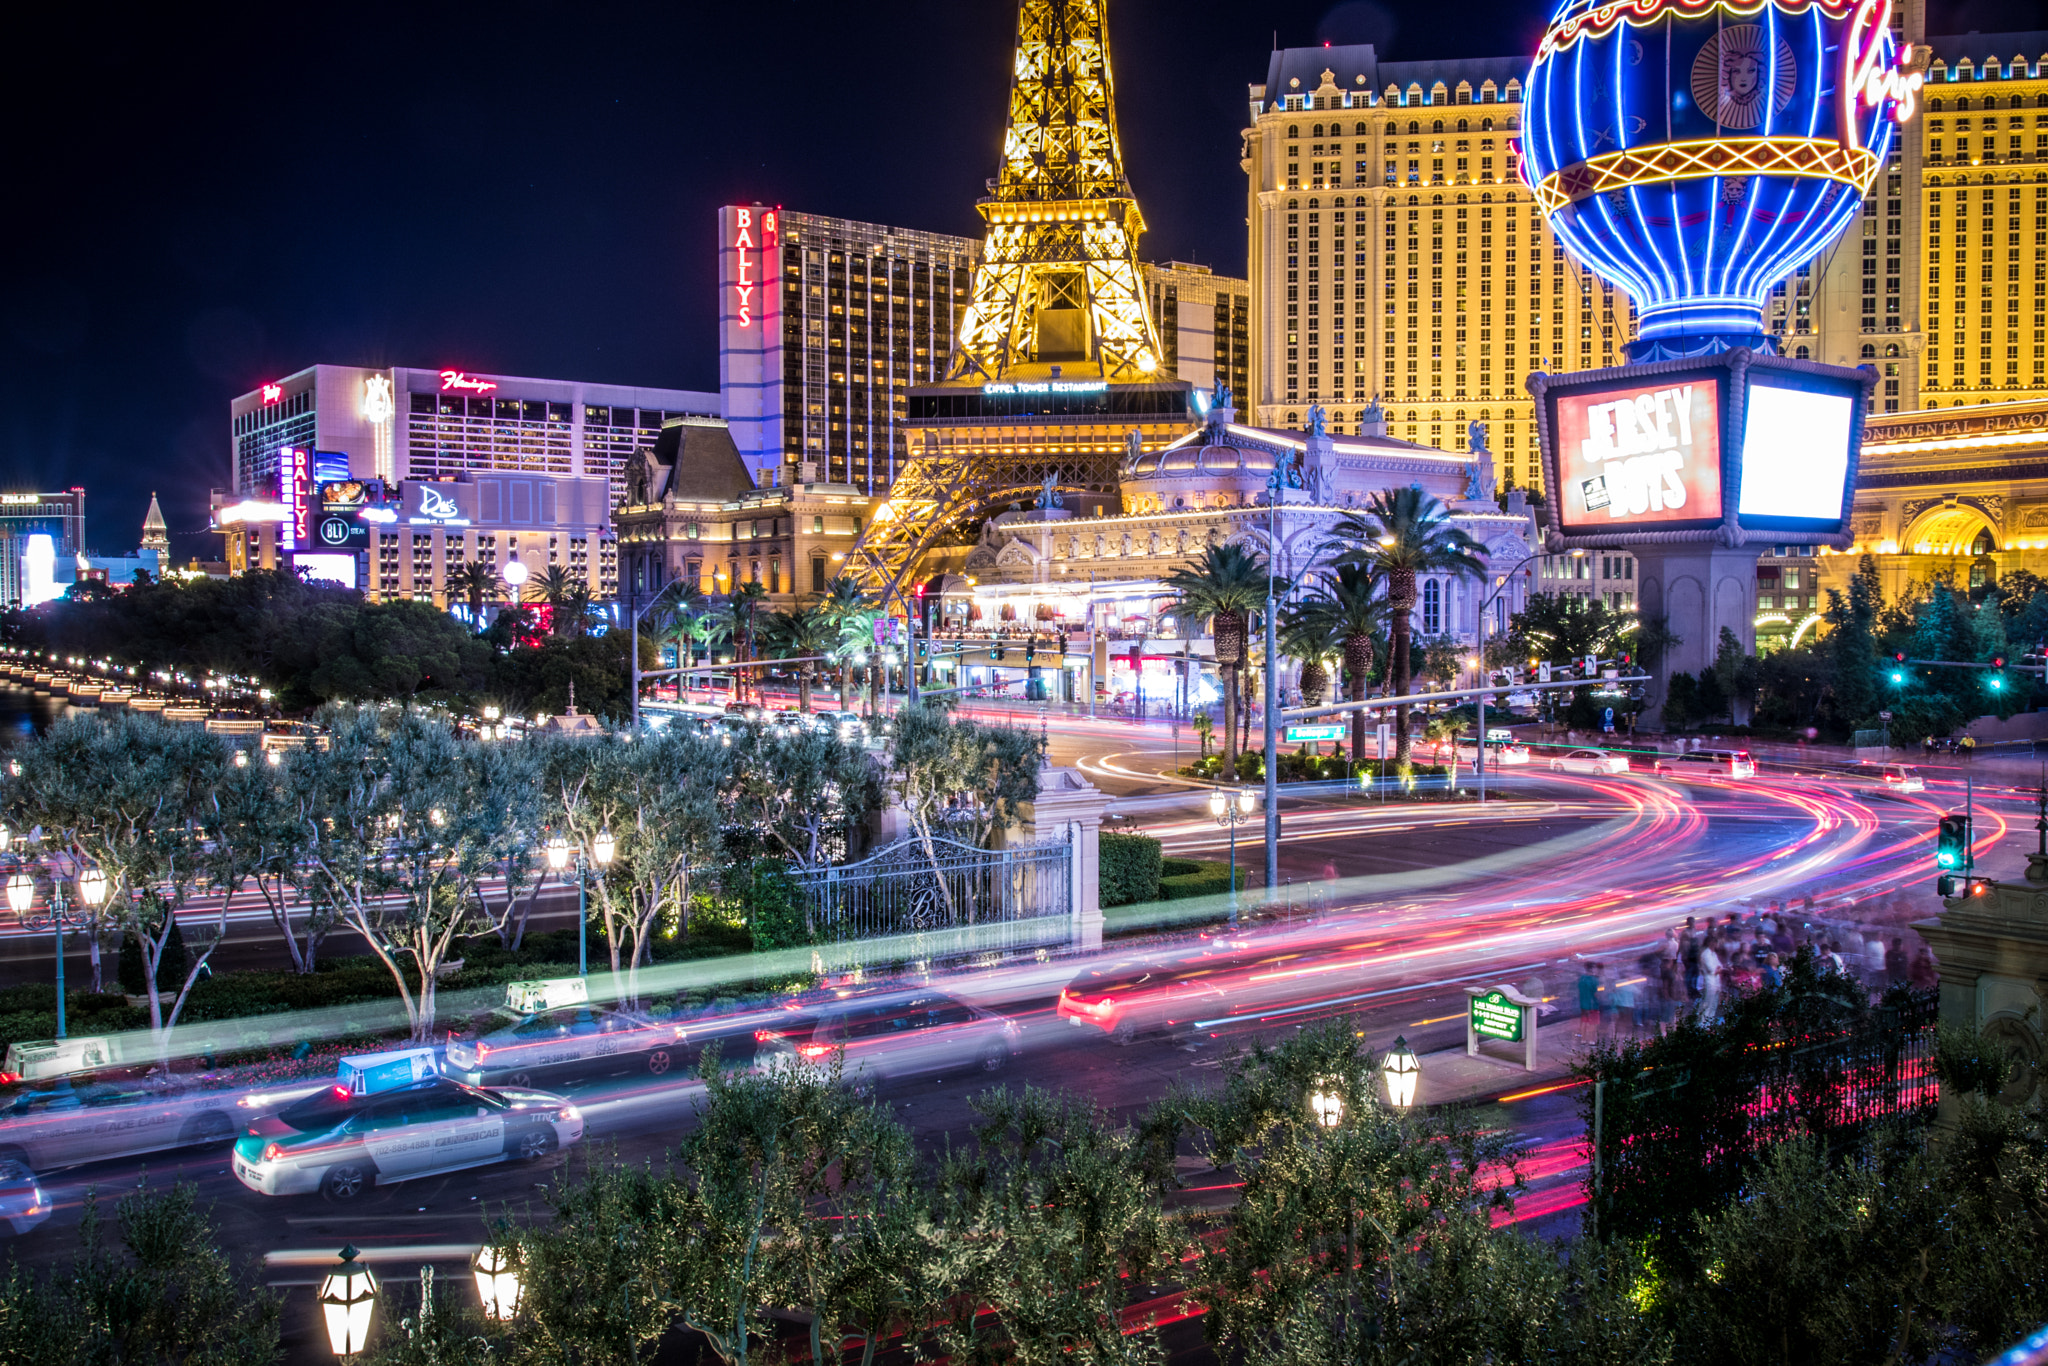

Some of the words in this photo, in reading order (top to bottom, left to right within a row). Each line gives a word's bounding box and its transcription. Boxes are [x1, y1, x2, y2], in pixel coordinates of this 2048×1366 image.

[1845, 0, 1923, 150] Paris
[735, 208, 754, 327] BALLYS
[440, 371, 497, 393] Flamingo
[985, 383, 1016, 394] EIFFEL
[1017, 382, 1049, 392] TOWER
[1052, 381, 1108, 392] RESTAURANT
[1581, 385, 1692, 463] JERSEY
[293, 451, 307, 538] BALLYS
[1604, 450, 1687, 518] BOYS
[327, 523, 343, 538] BLT
[350, 527, 366, 535] STEAK
[479, 1128, 499, 1139] CAB
